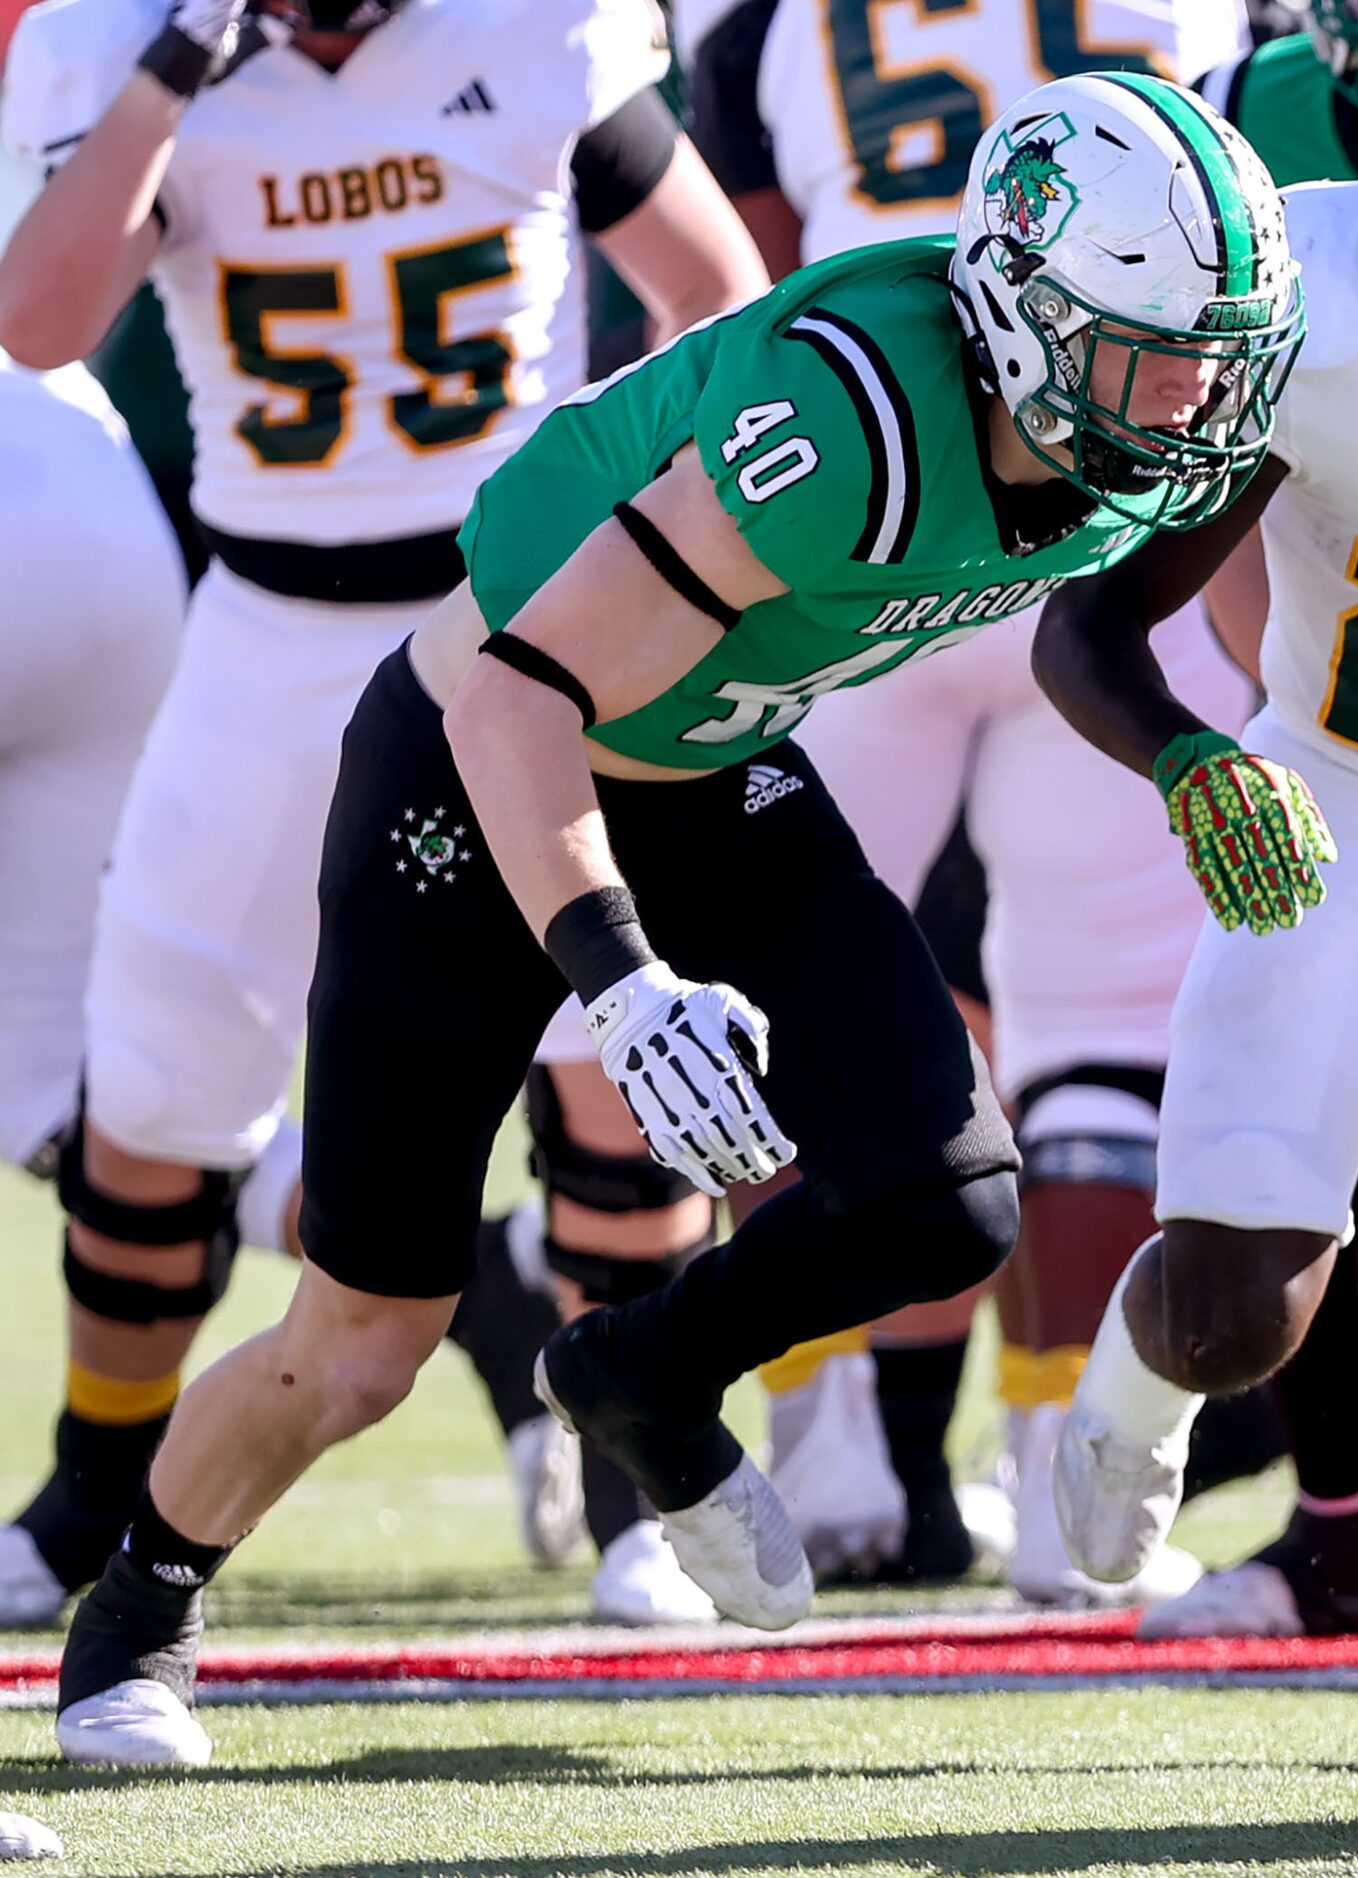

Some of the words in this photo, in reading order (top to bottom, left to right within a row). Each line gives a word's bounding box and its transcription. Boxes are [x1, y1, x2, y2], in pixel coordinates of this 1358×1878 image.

[258, 152, 445, 231] LOBOS
[213, 221, 522, 470] 55
[720, 398, 822, 504] 40
[860, 575, 1068, 635] DRAGON
[743, 774, 804, 815] adidas
